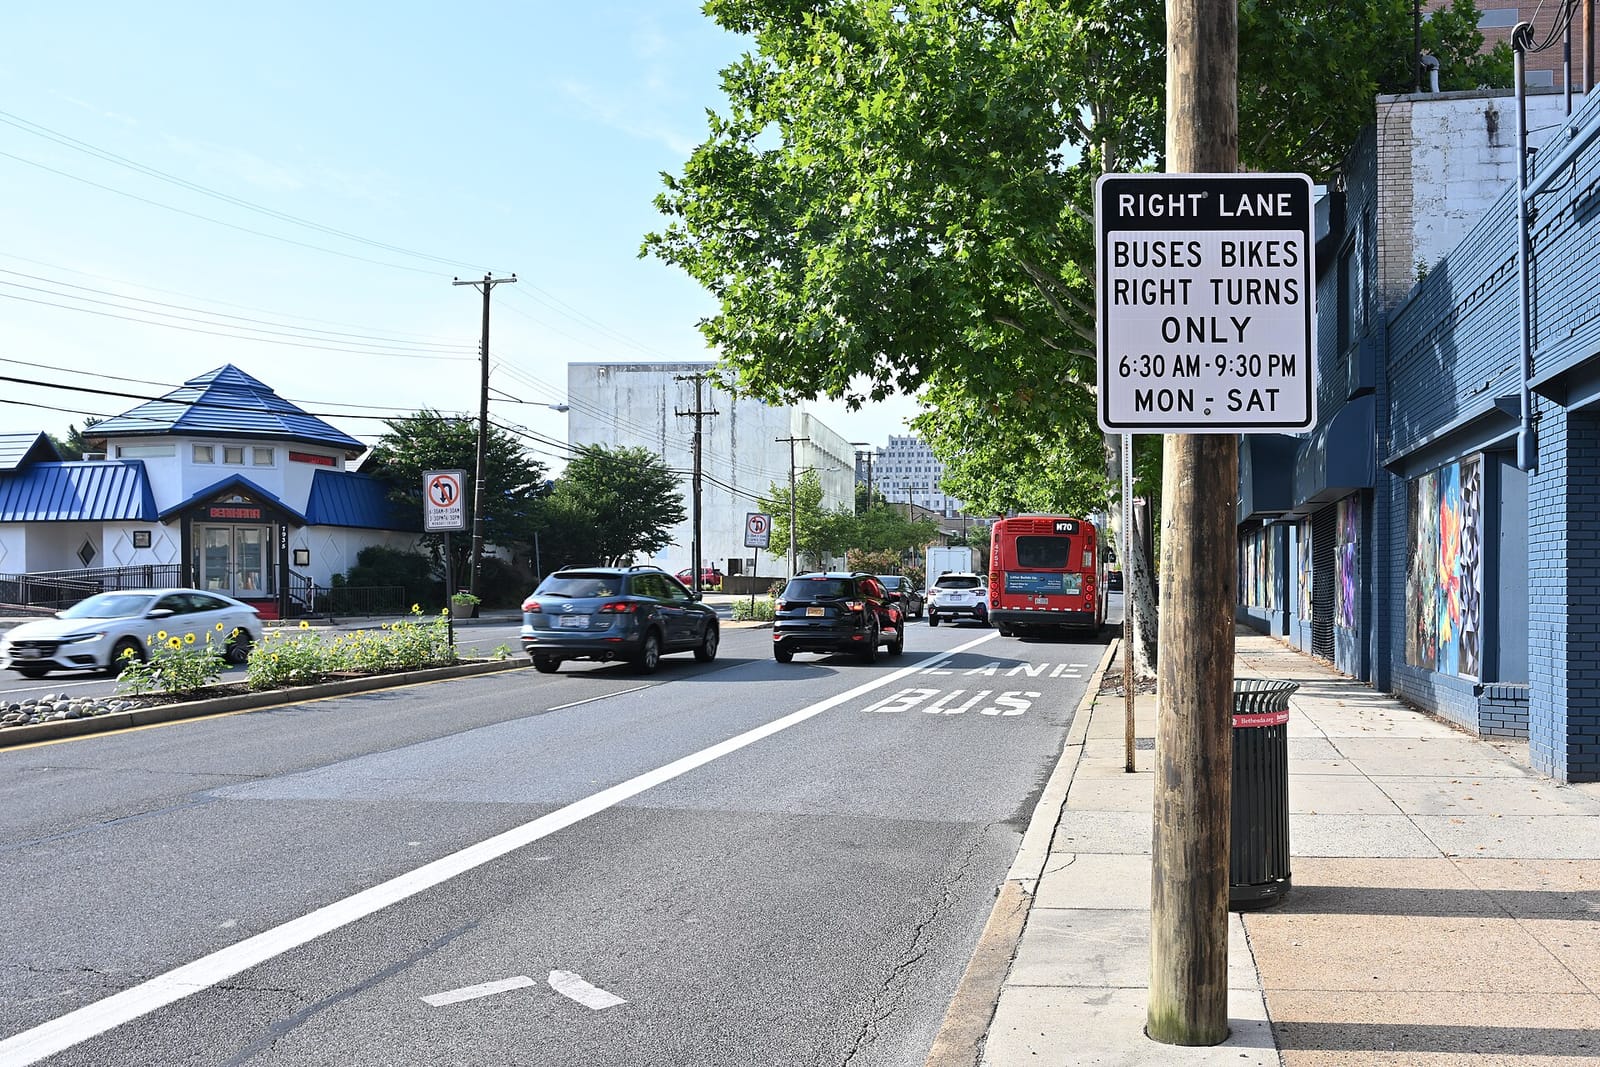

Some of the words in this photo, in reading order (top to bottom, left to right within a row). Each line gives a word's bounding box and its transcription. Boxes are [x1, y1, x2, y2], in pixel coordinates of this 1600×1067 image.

[1119, 193, 1202, 217] RIGHT
[1219, 193, 1292, 217] LANE
[1114, 241, 1202, 268] BUSES
[1221, 241, 1298, 268] BIKES
[1114, 279, 1192, 306] RIGHT
[1210, 279, 1299, 306] TURNS
[1161, 316, 1251, 344] ONLY
[1119, 354, 1165, 378] 6:30
[1268, 354, 1296, 378] PM
[1135, 388, 1194, 412] MON
[1227, 388, 1280, 412] SAT
[919, 660, 1089, 678] LANE
[860, 688, 1042, 716] BUS
